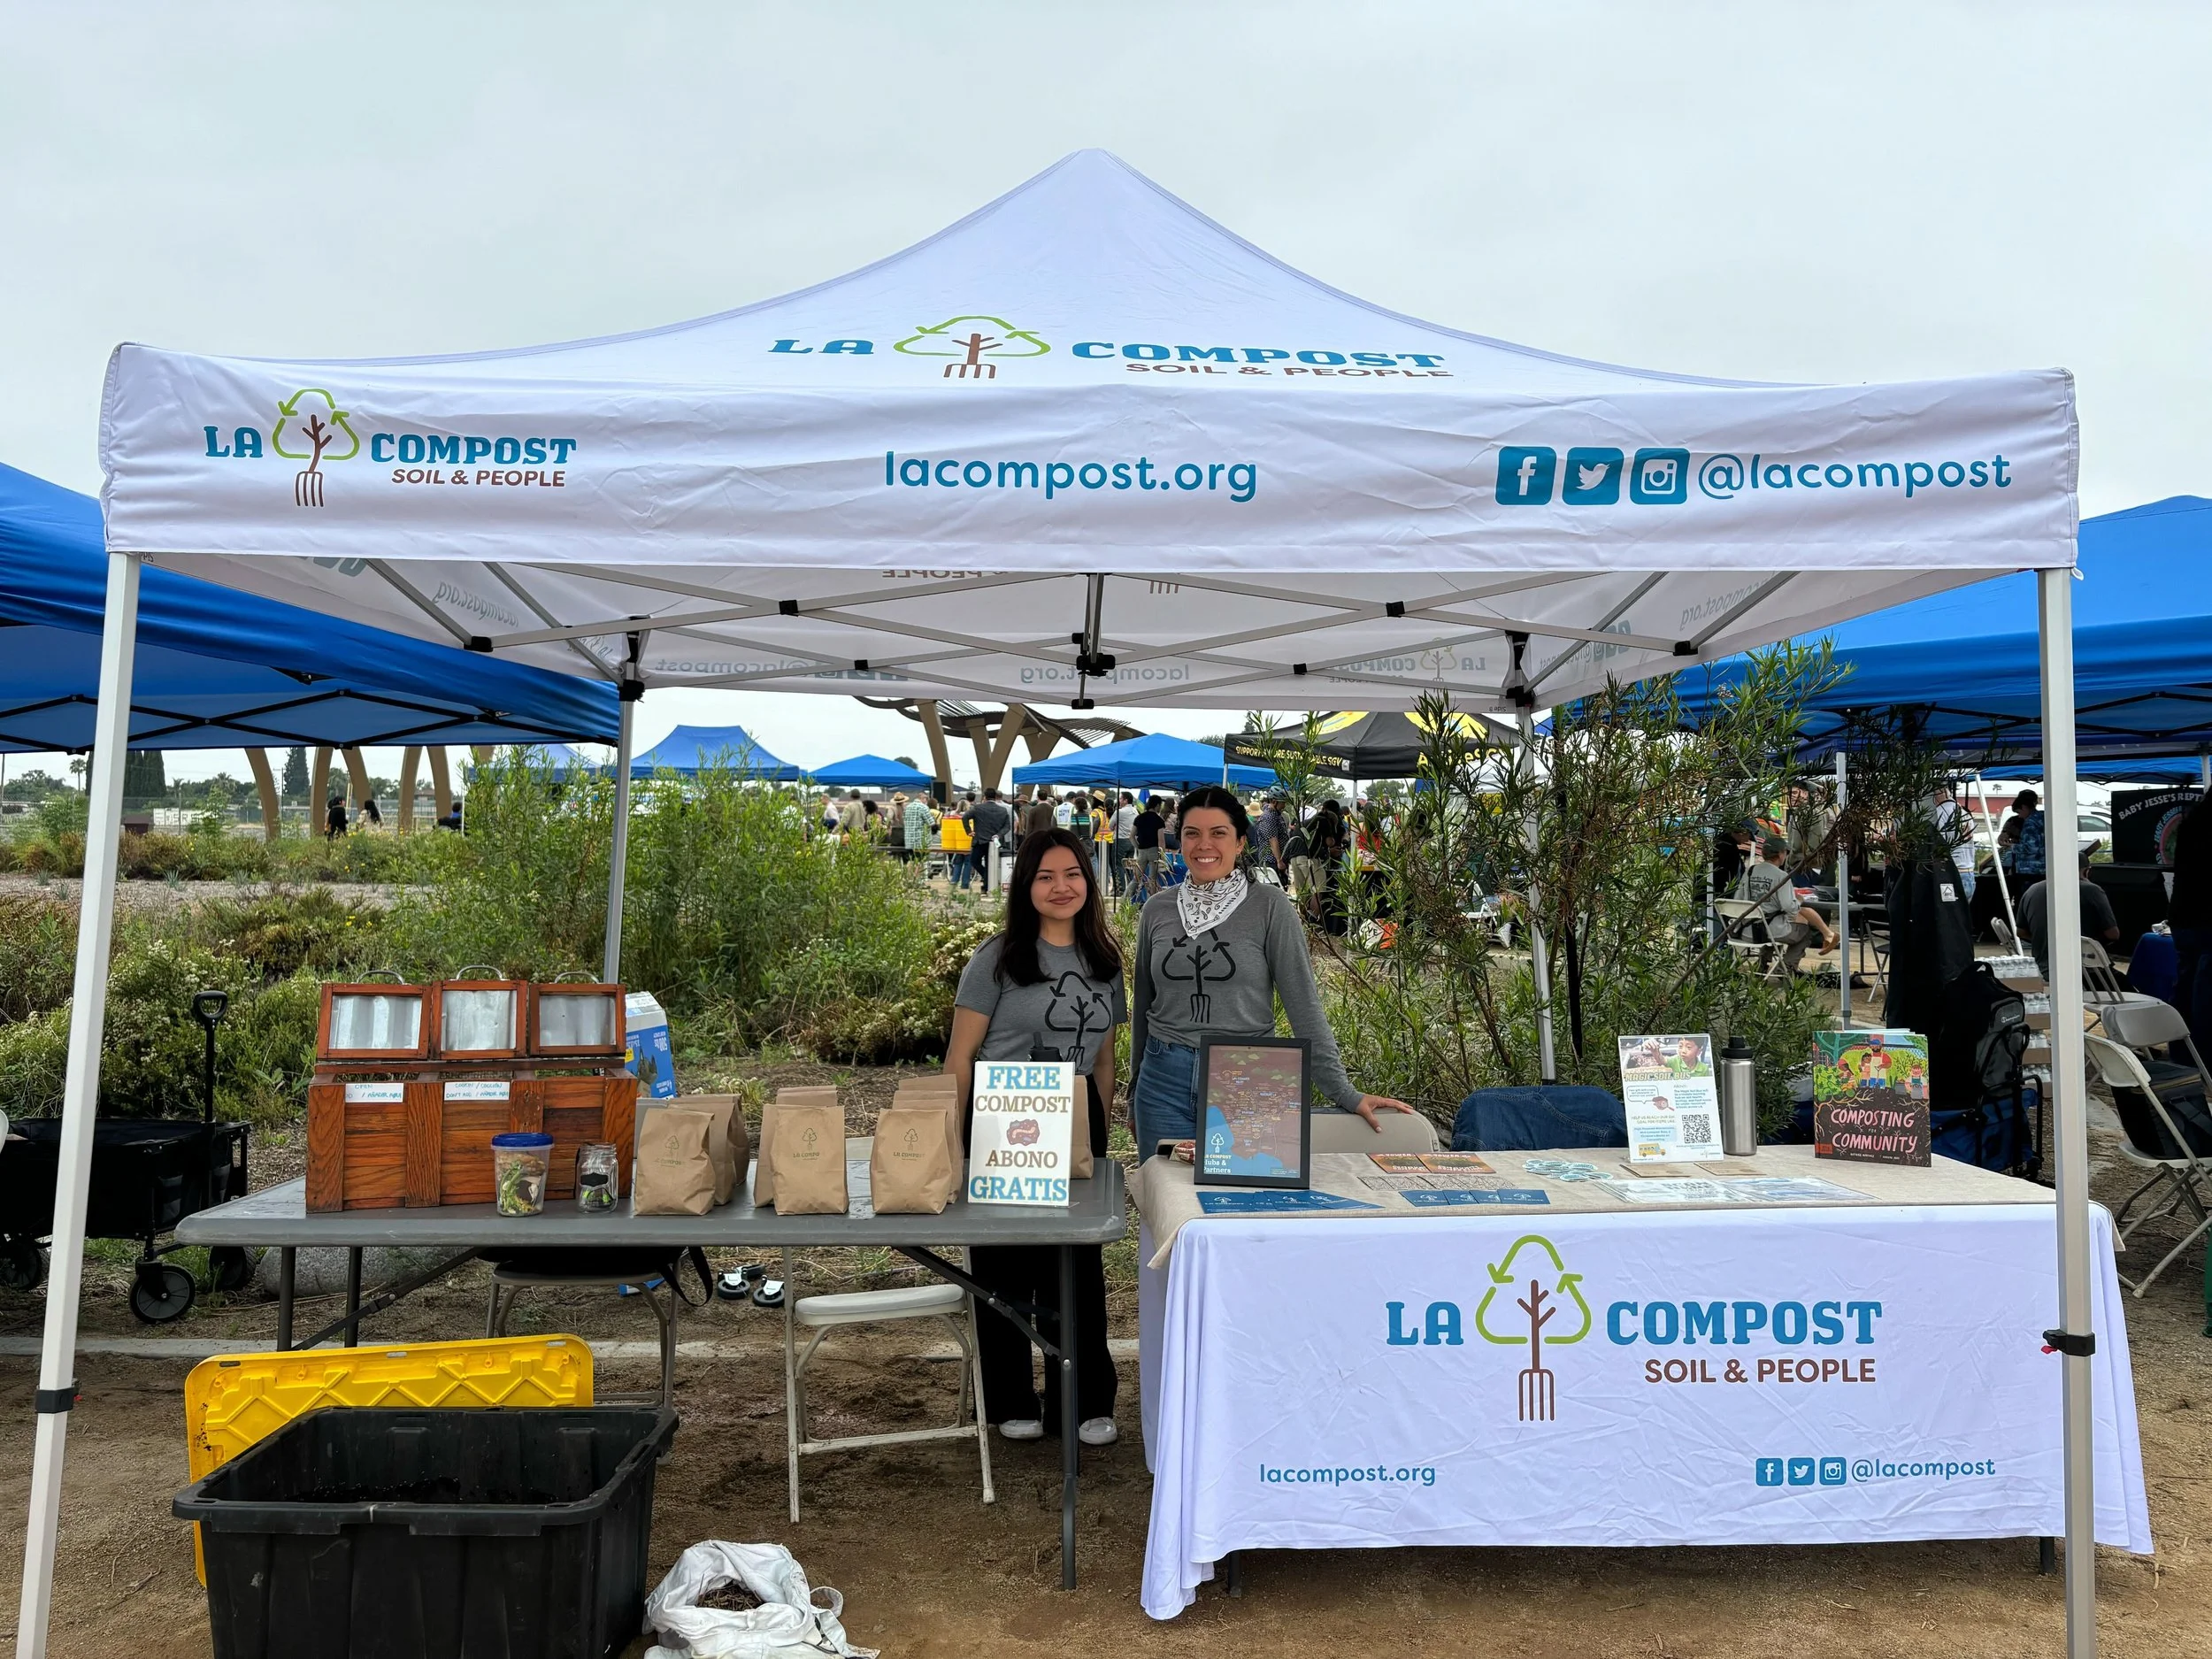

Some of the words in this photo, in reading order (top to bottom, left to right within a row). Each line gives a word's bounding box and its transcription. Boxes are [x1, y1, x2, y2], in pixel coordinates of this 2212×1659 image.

[770, 339, 873, 355] LA
[1071, 342, 1445, 368] COMPOST
[1125, 362, 1227, 374] SOIL
[1238, 365, 1268, 375] &
[1280, 366, 1454, 378] PEOPLE
[204, 426, 263, 458] LA
[371, 433, 577, 465] COMPOST
[391, 469, 445, 485] SOIL
[451, 470, 468, 485] &
[477, 470, 565, 488] PEOPLE
[886, 450, 1256, 503] lacompost.org
[1698, 453, 2012, 500] @lacompost
[1286, 749, 1327, 765] SUSTAABLE
[2118, 802, 2142, 820] BABY
[2144, 794, 2177, 809] JESSE'S
[987, 1066, 1061, 1090] FREE
[1624, 1073, 1653, 1082] MAGIC
[1653, 1071, 1672, 1081] SOIL
[974, 1095, 1071, 1113] COMPOST
[1831, 1109, 1916, 1127] COMPOSTING
[1832, 1133, 1918, 1153] COMMUNITY
[986, 1150, 1058, 1168] ABONO
[970, 1175, 1067, 1202] GRATIS
[1386, 1301, 1463, 1346] LA
[1606, 1300, 1883, 1346] COMPOST
[1644, 1358, 1717, 1383] SOIL
[1724, 1358, 1748, 1383] &
[1757, 1358, 1876, 1383] PEOPLE
[1258, 1463, 1436, 1487] lacompost.org
[1851, 1458, 1996, 1483] @lacompost
